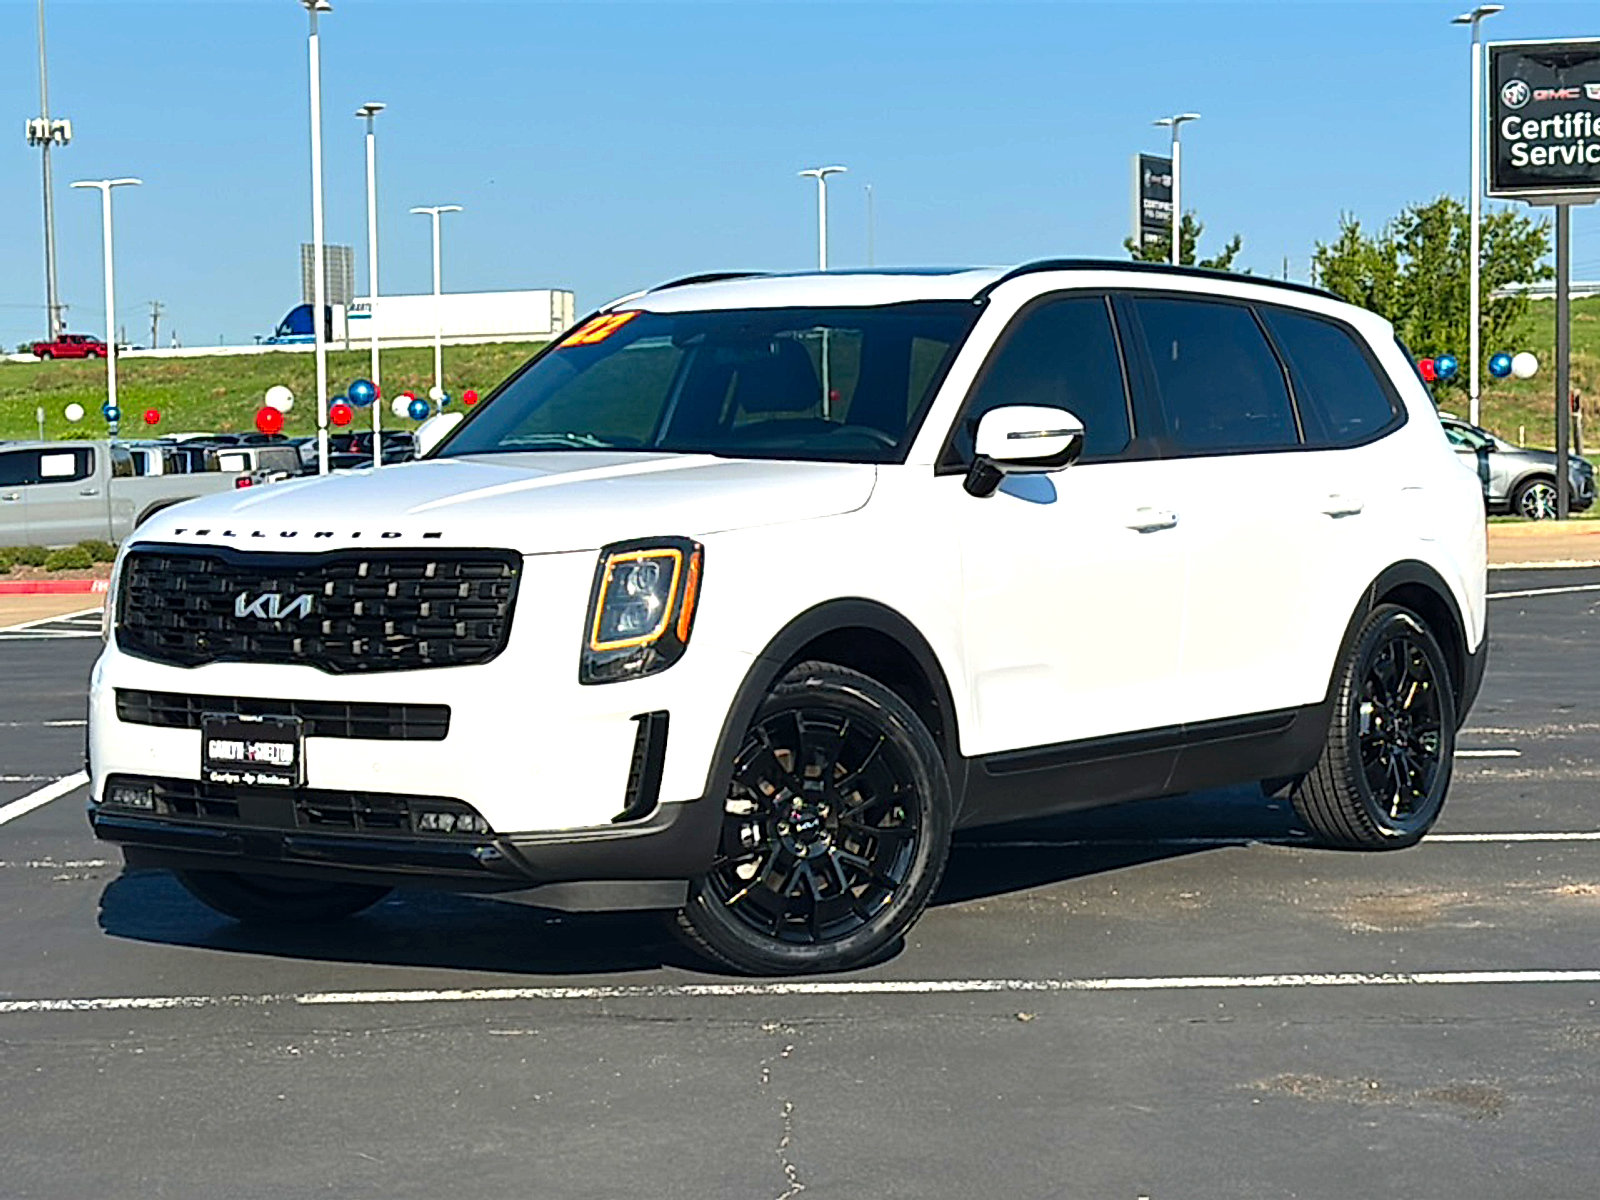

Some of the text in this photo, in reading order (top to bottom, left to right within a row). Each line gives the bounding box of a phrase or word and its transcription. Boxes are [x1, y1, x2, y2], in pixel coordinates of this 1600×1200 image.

[1533, 87, 1581, 100] GMC
[1511, 139, 1600, 167] Servic
[174, 528, 442, 539] TELLURIDE
[234, 591, 314, 620] KIA
